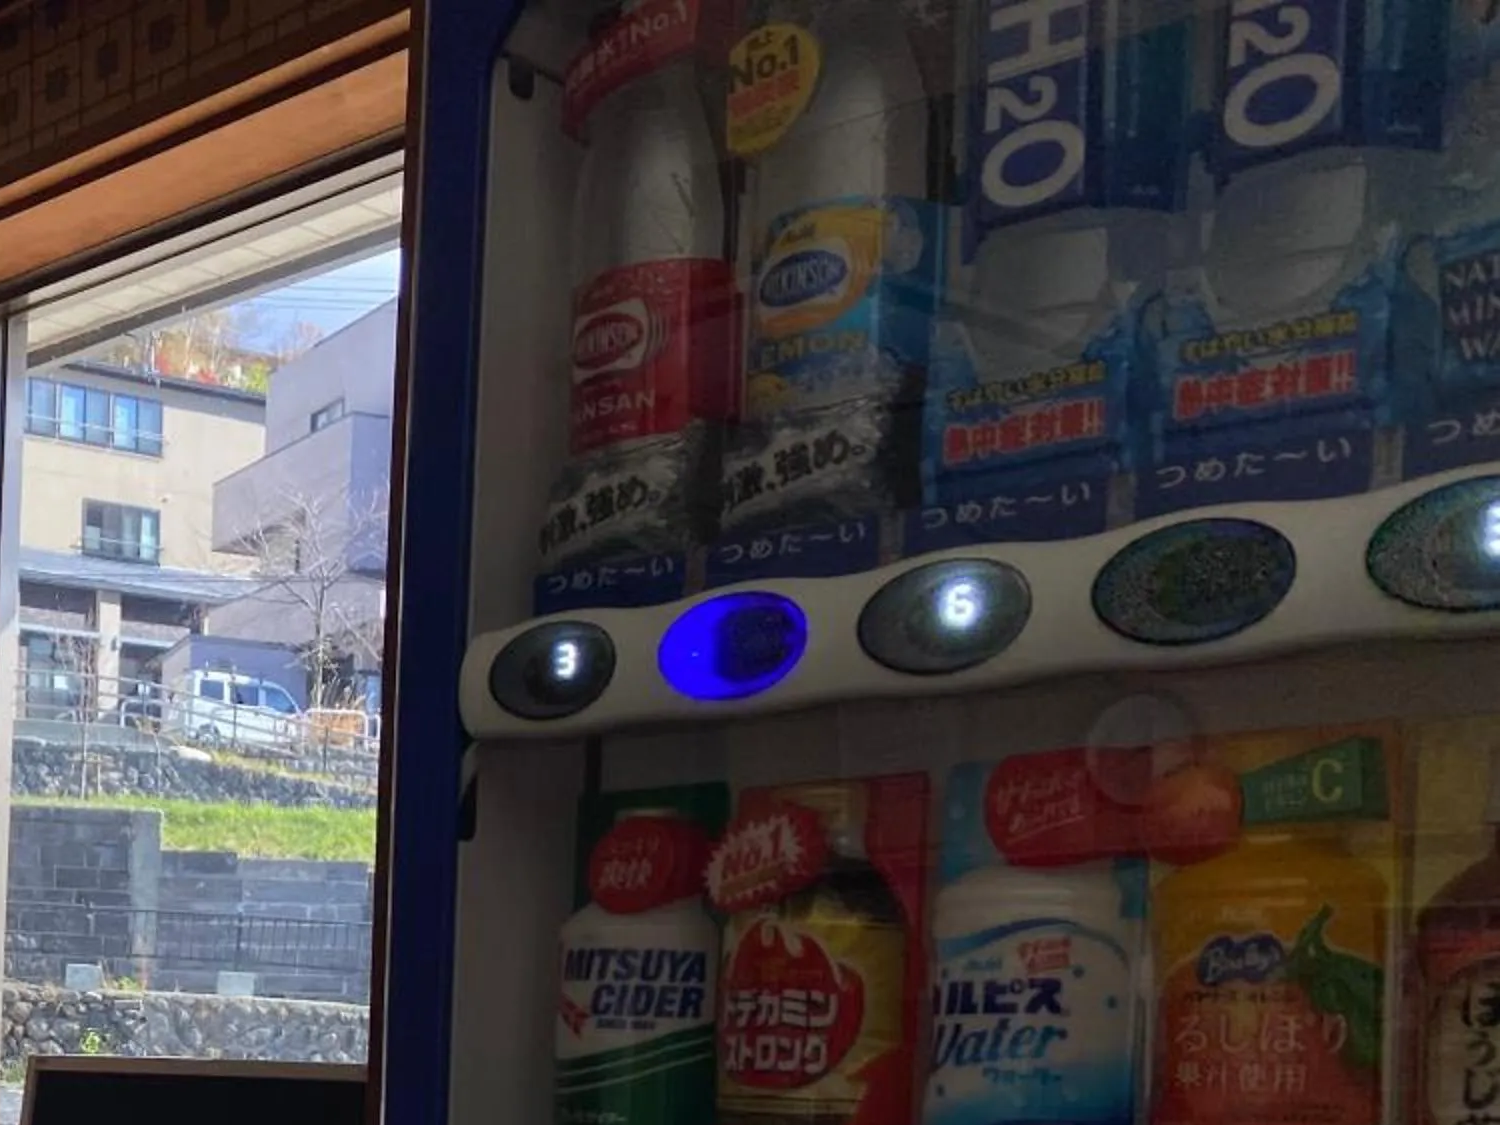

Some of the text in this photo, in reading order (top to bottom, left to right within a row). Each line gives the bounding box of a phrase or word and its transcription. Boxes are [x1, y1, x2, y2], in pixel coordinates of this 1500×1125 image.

[731, 34, 799, 90] No.1
[572, 387, 657, 423] NSAN
[555, 642, 577, 677] 3
[1311, 758, 1344, 802] C
[564, 948, 706, 983] MITSUYA
[591, 984, 706, 1018] CIDER
[1175, 1060, 1308, 1094] 果汁使用
